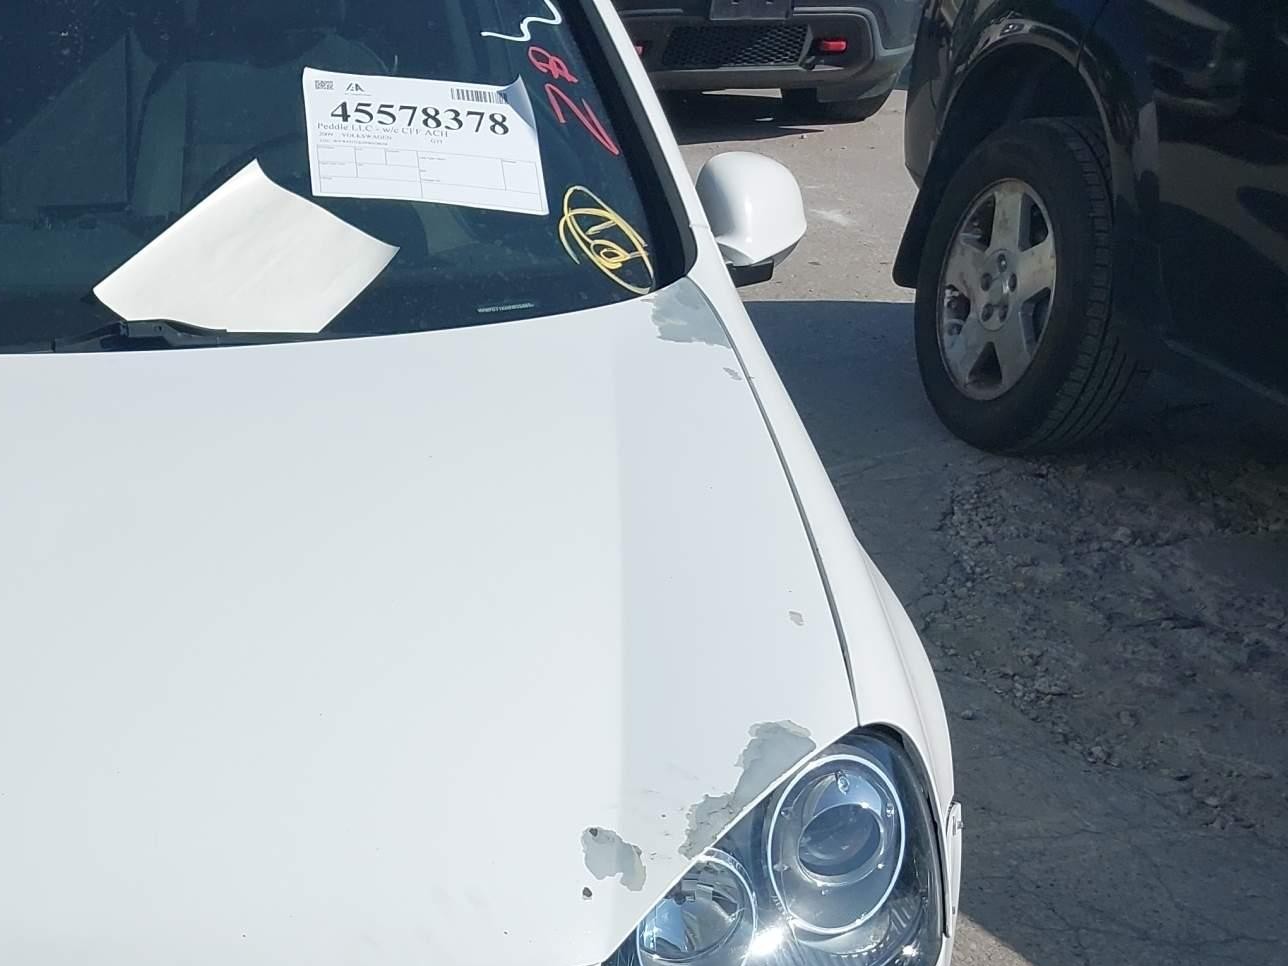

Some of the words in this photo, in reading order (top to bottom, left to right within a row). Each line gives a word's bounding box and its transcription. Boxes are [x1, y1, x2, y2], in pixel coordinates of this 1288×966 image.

[317, 122, 348, 131] Peddle
[351, 124, 373, 132] LLC
[330, 101, 509, 135] 45578378
